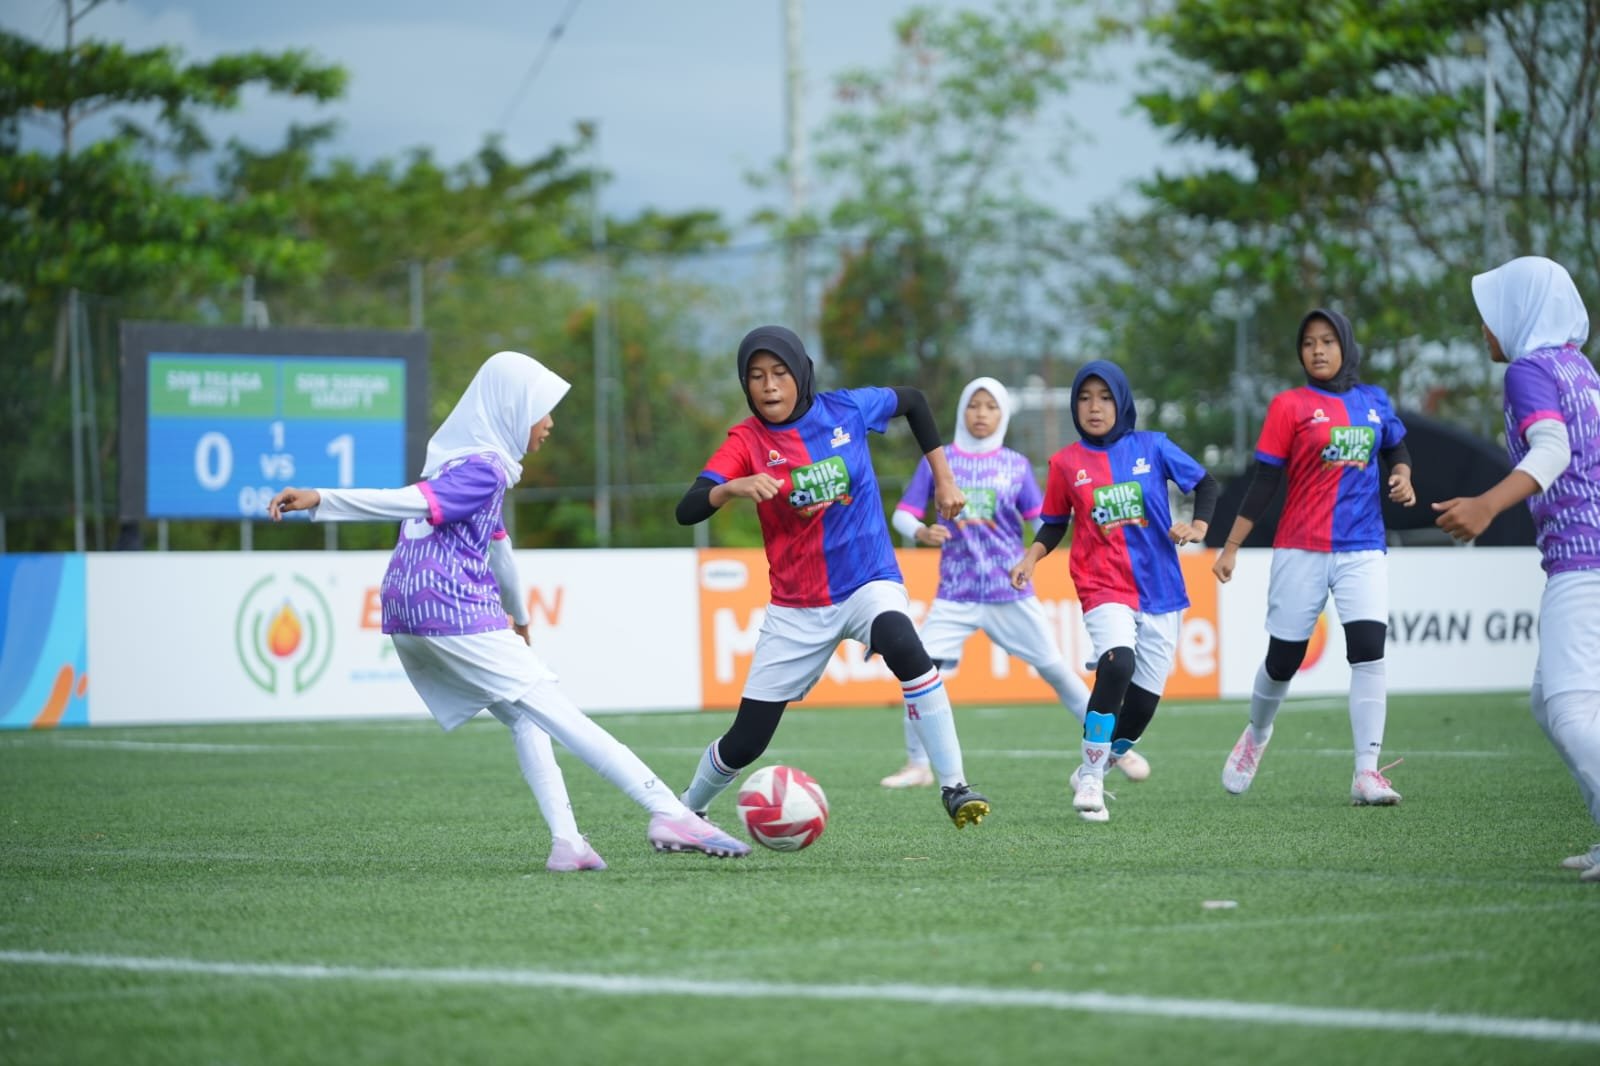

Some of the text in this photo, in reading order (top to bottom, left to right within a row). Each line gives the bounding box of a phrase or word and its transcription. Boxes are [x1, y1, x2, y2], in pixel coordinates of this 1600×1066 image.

[270, 421, 285, 450] 1
[1335, 429, 1371, 446] Milk
[194, 432, 233, 491] 0
[260, 453, 295, 480] VS
[326, 434, 355, 488] 1
[796, 462, 843, 488] Milk
[810, 480, 847, 503] Life
[1098, 485, 1139, 506] Milk
[1109, 501, 1142, 520] Life
[1485, 611, 1541, 642] GR
